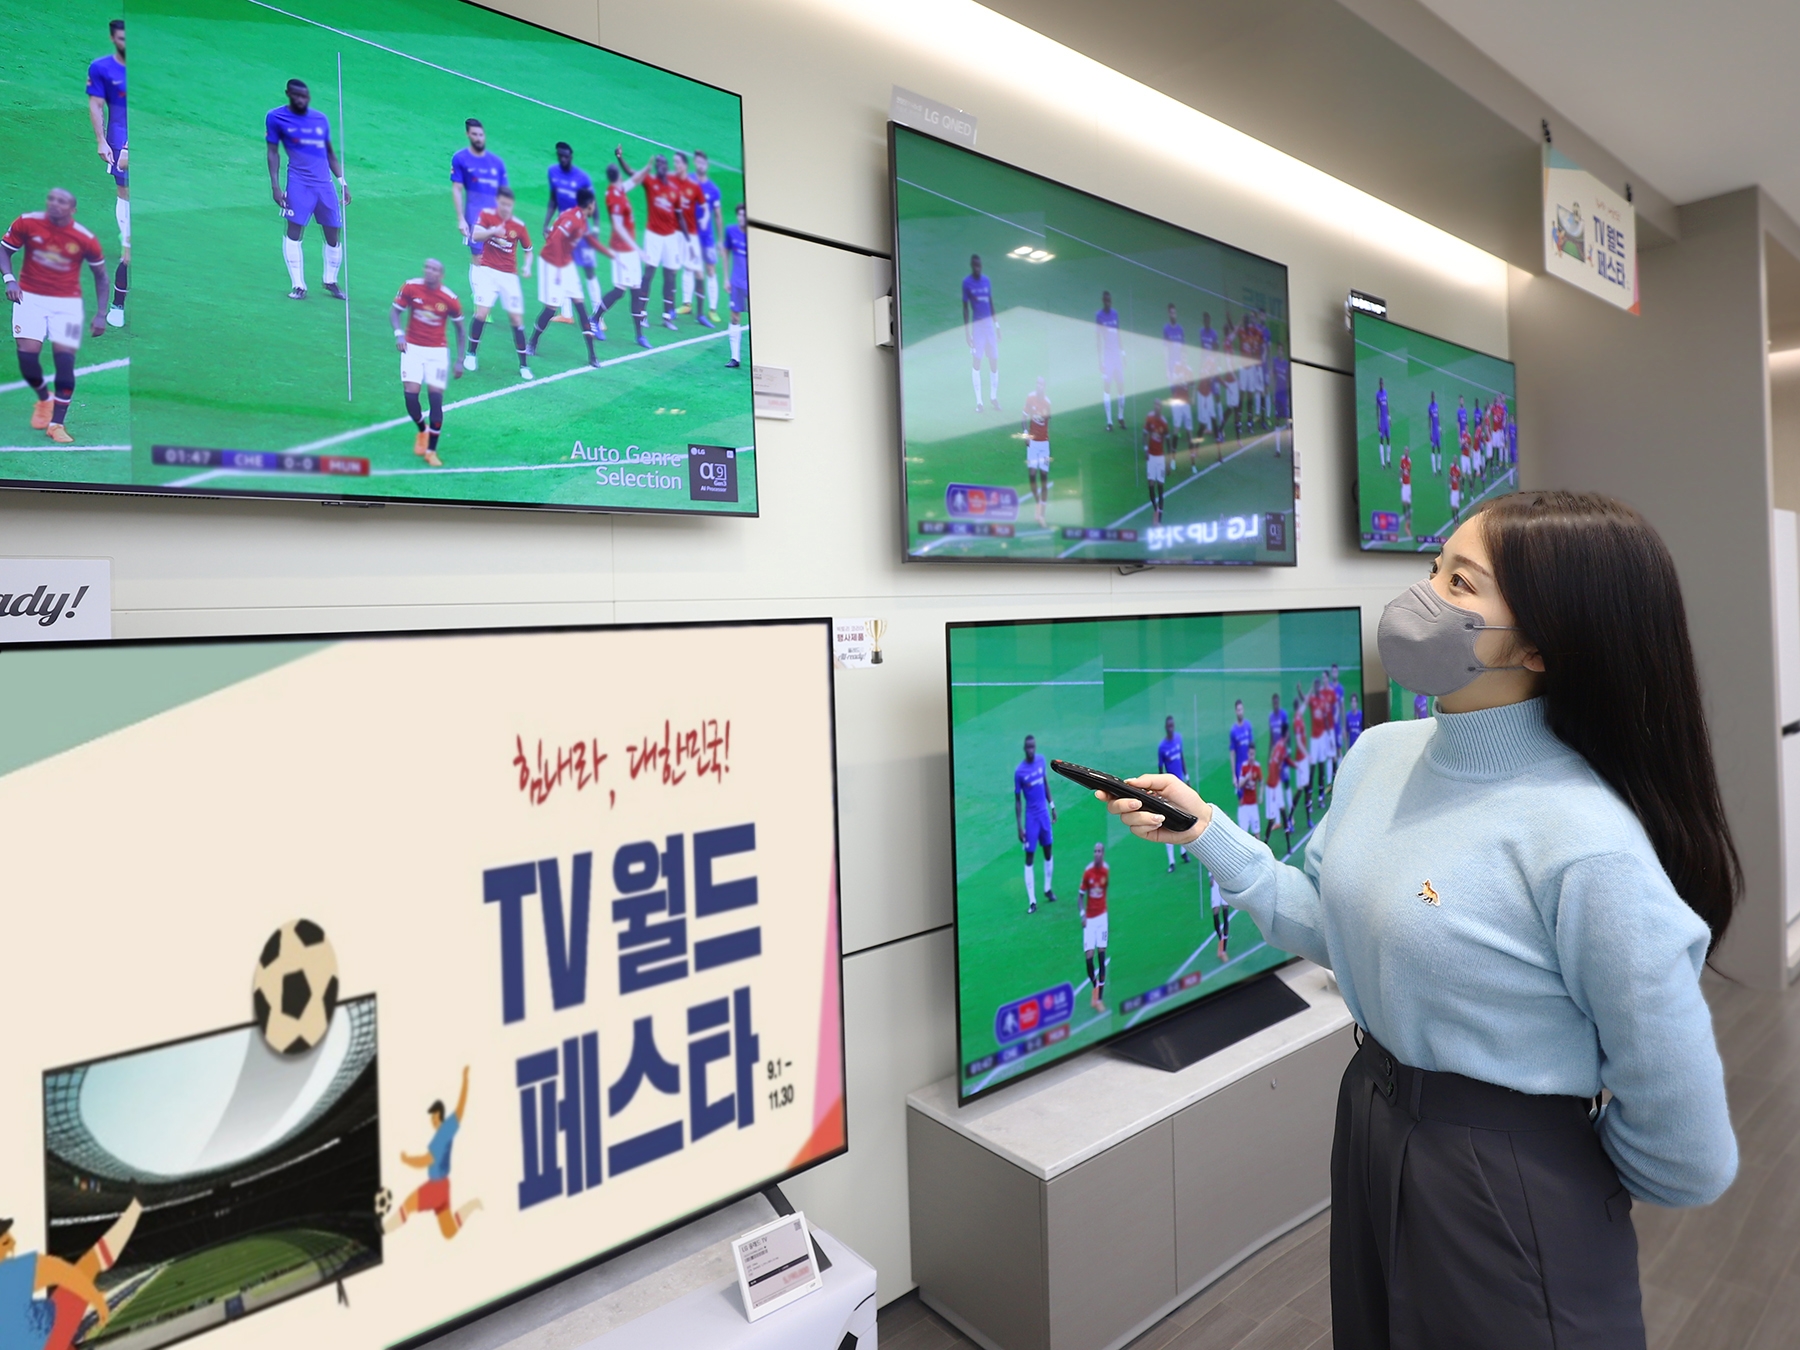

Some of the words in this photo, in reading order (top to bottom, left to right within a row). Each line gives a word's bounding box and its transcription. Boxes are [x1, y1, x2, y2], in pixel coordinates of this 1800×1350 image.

[924, 108, 940, 125] LG
[942, 115, 972, 136] QNED
[1593, 215, 1605, 247] TV
[1607, 224, 1626, 259] 월드
[1597, 250, 1626, 289] 페스타
[165, 449, 211, 465] 01:47
[233, 453, 265, 468] CHE
[328, 459, 361, 473] MUN
[571, 441, 620, 464] Auto
[626, 445, 682, 468] Genre
[596, 466, 682, 490] Selection
[837, 633, 864, 642] 행사제품
[512, 733, 617, 811] 힘내라,
[625, 718, 731, 787] 대한민국!
[482, 851, 593, 1026] TV
[611, 822, 762, 996] 월드
[767, 1058, 781, 1081] 9.1
[516, 985, 760, 1212] 페스타
[768, 1083, 794, 1110] 11.30
